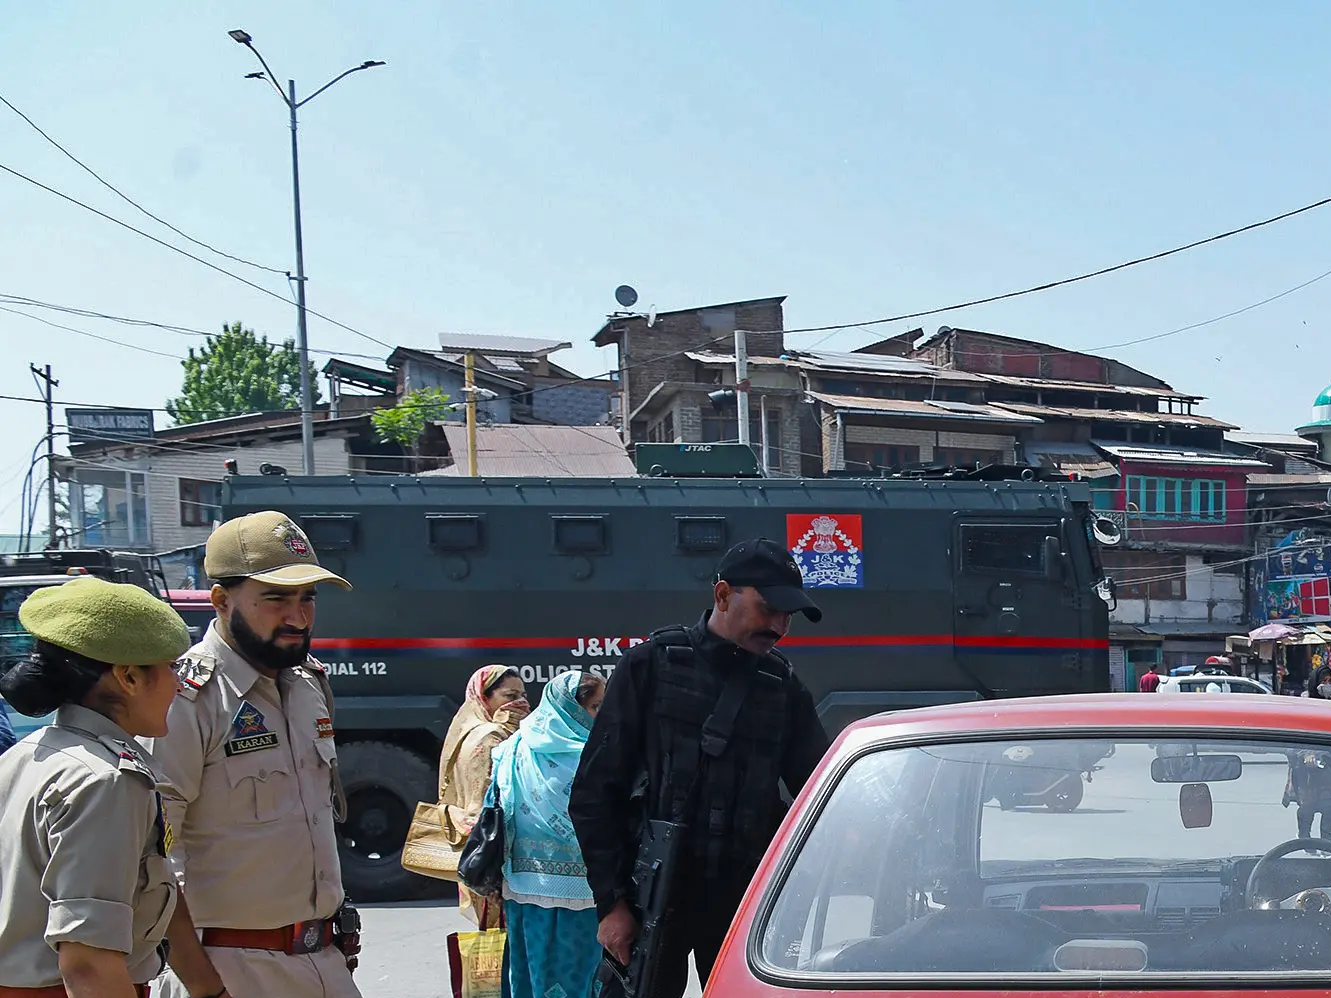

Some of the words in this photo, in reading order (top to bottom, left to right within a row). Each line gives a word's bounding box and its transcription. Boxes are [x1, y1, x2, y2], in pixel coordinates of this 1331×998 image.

[811, 554, 845, 563] J&K
[571, 638, 622, 656] J&K
[323, 663, 358, 675] DIAL
[362, 662, 387, 675] 112
[508, 665, 582, 683] OLI
[236, 736, 272, 750] KARAN
